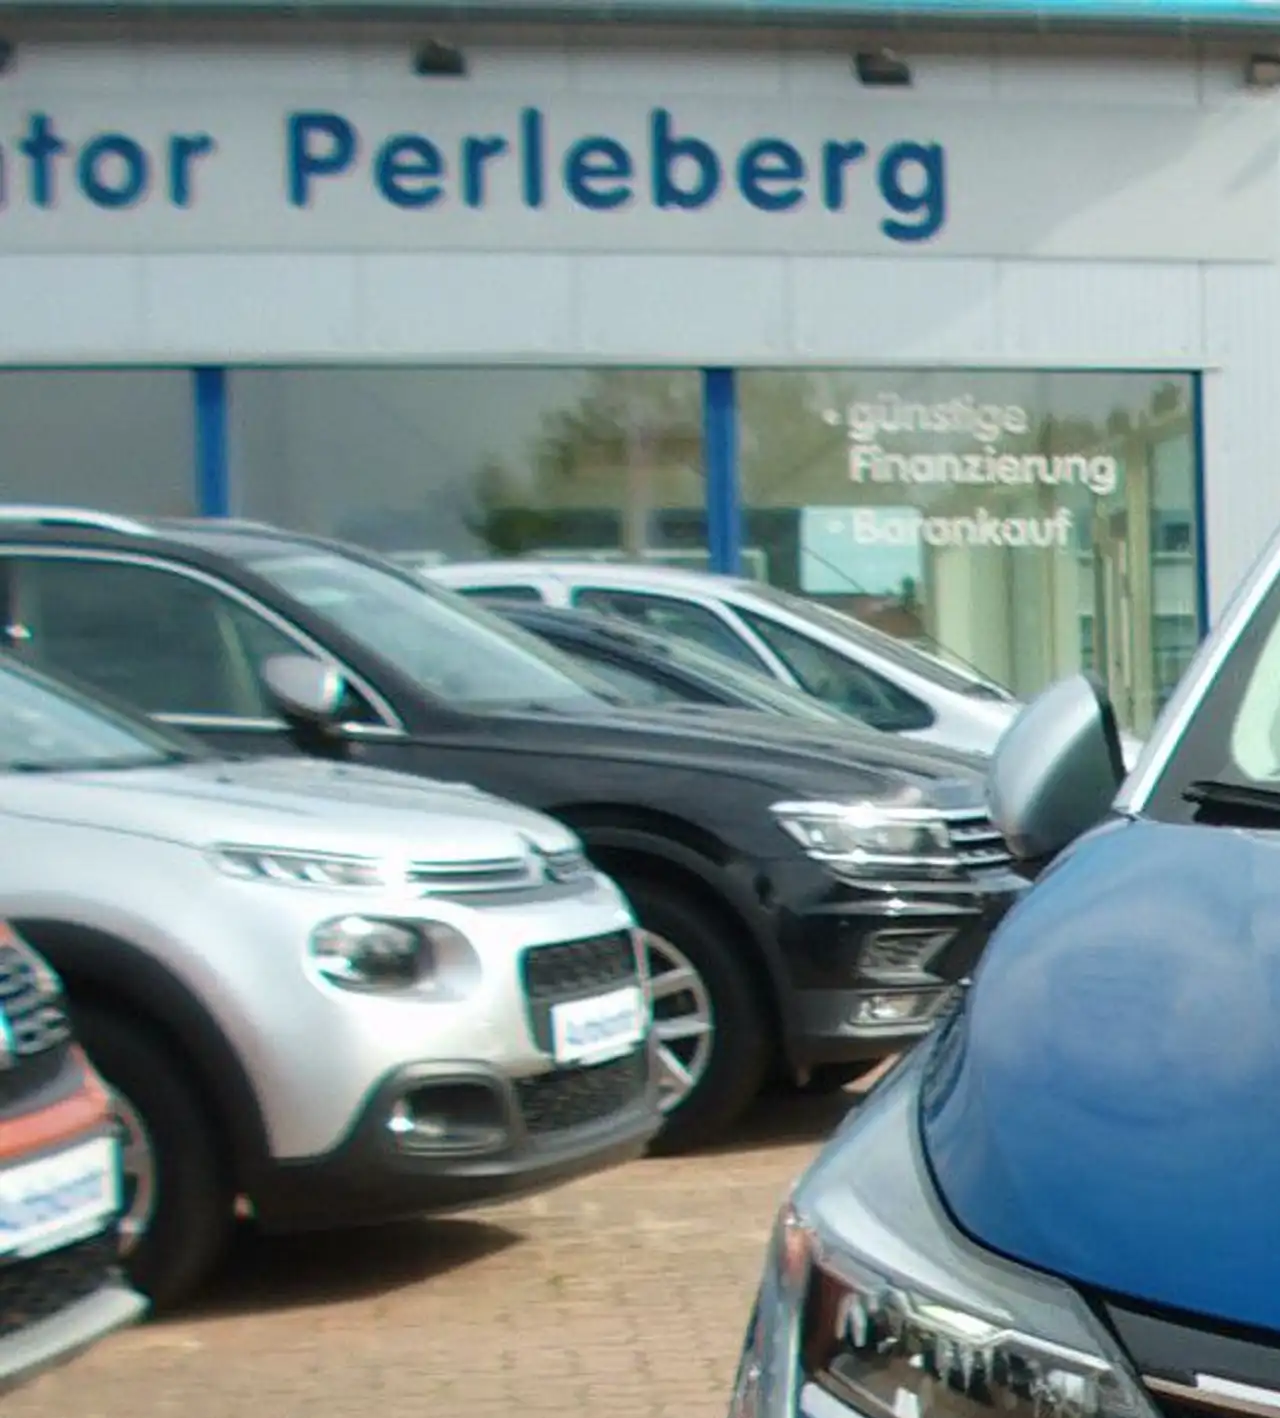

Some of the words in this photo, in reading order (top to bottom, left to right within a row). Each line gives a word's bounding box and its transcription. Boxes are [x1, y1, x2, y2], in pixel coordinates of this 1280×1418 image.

[0, 109, 215, 209] tor
[286, 106, 946, 242] Perleberg
[846, 393, 1030, 442] günstige
[848, 444, 1119, 495] Finanzierung
[851, 506, 1074, 548] Barankauf
